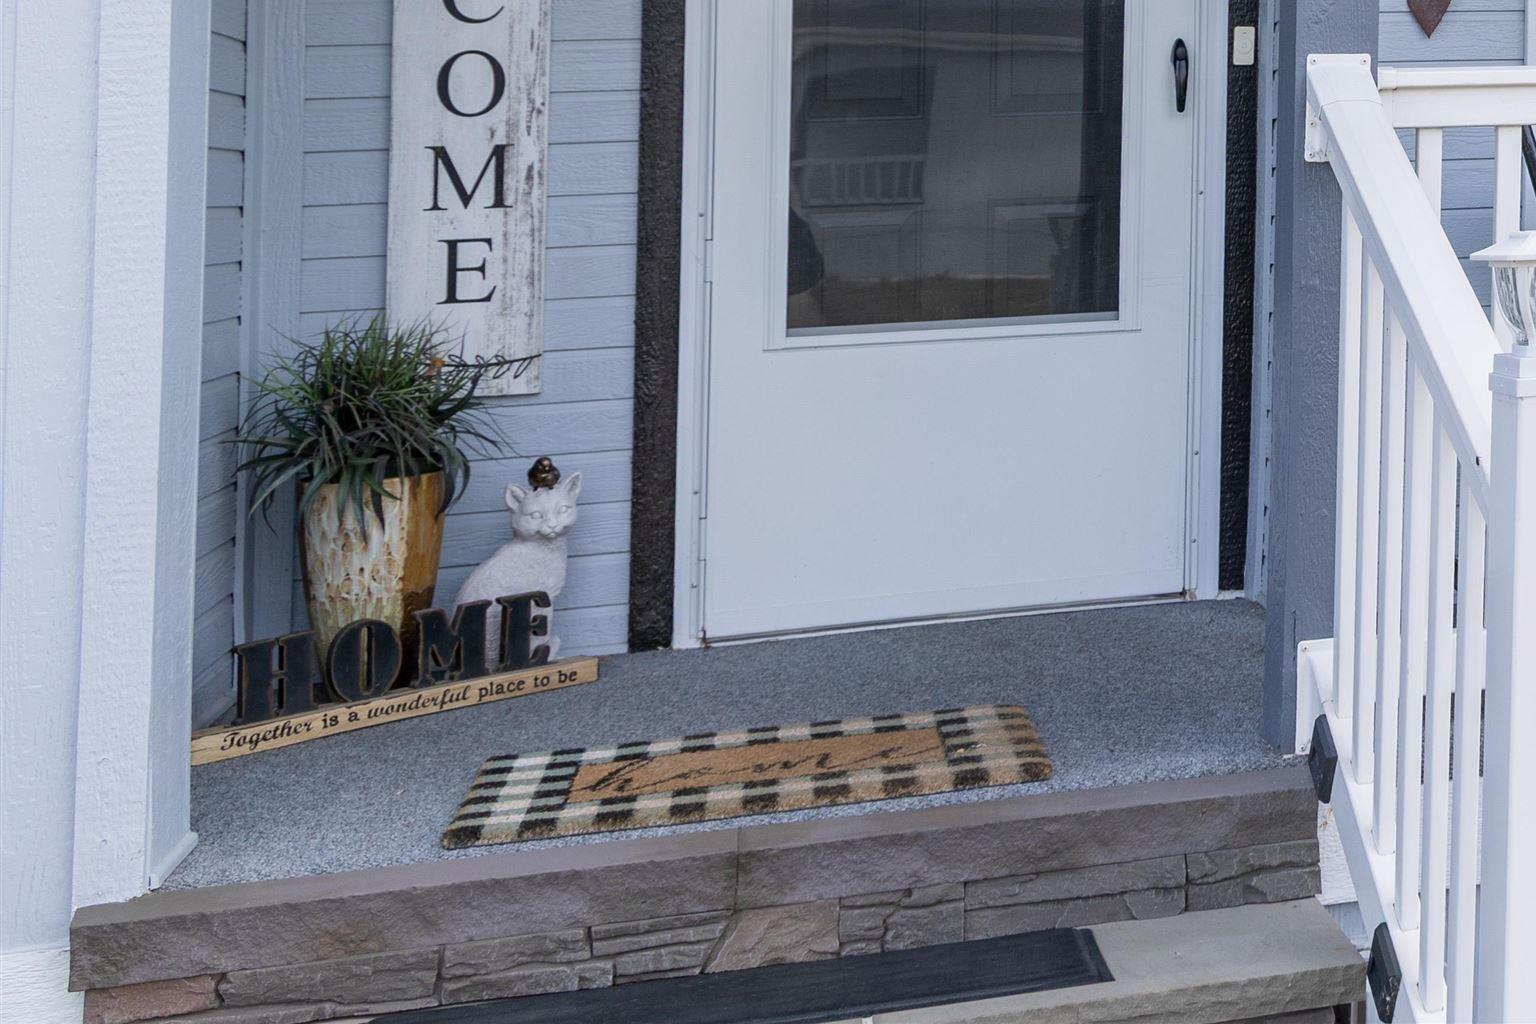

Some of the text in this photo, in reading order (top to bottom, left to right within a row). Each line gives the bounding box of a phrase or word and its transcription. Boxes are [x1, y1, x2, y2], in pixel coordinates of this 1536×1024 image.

[220, 668, 578, 752] Together is a wonderful place to be
[231, 590, 552, 725] HOME
